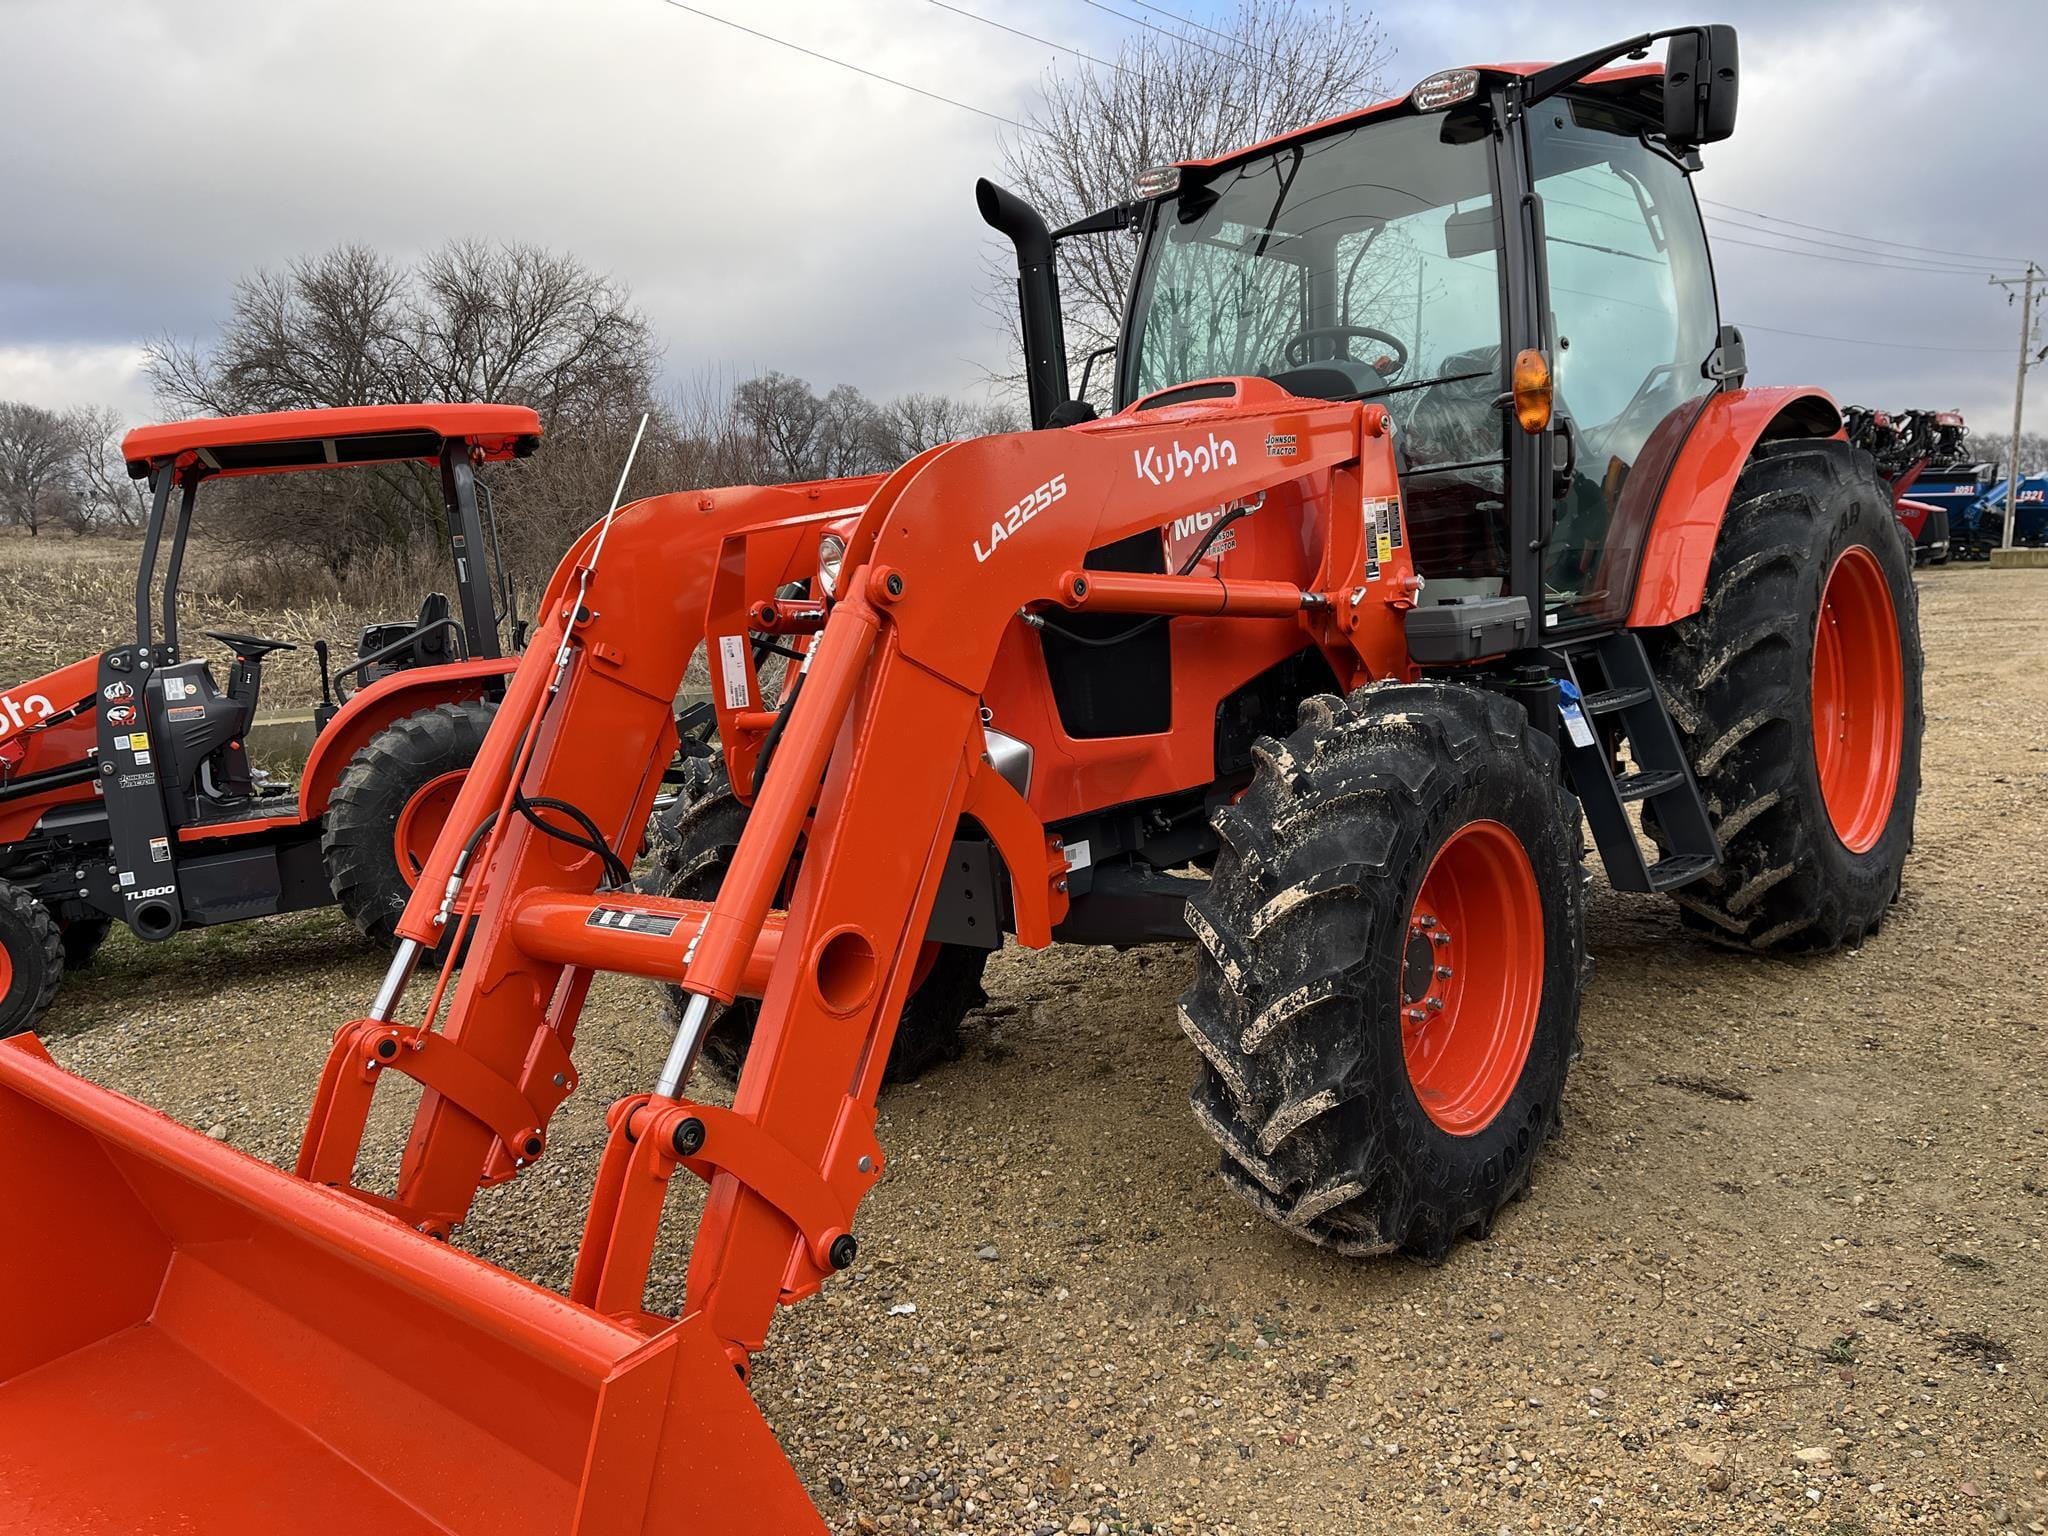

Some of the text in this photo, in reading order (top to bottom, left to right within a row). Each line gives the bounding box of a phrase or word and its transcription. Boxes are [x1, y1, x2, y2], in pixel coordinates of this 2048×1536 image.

[1265, 432, 1297, 444] JOHNSON
[1266, 444, 1297, 456] TRACTOR
[1134, 432, 1237, 486] Kubota
[973, 473, 1067, 563] LA2255
[124, 884, 176, 901] TL1800
